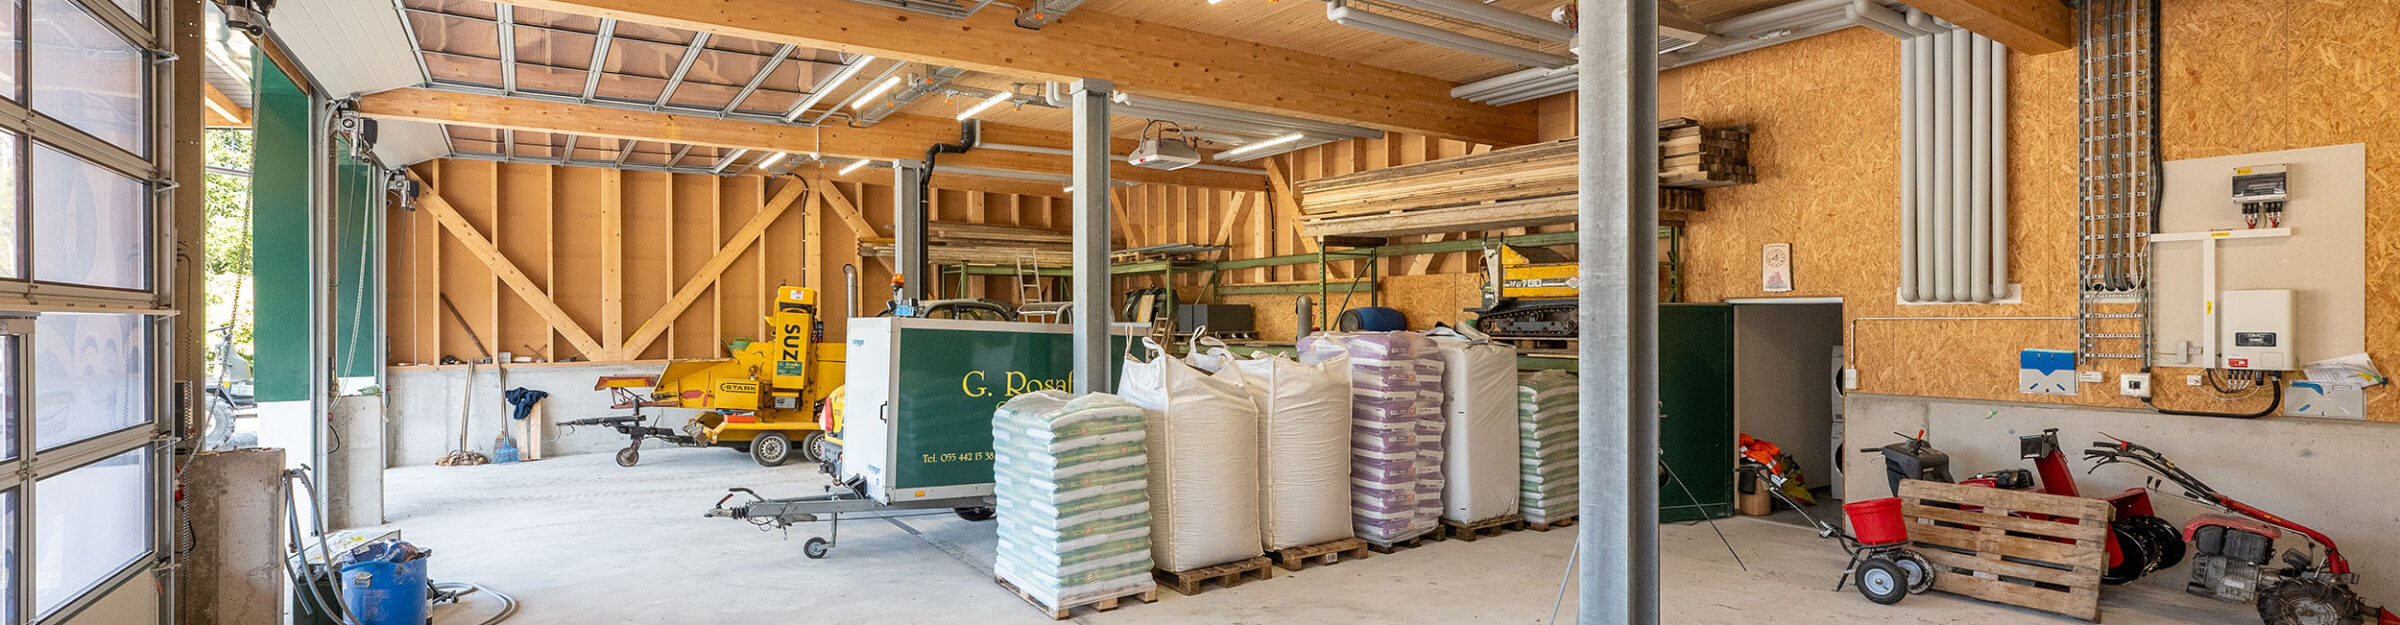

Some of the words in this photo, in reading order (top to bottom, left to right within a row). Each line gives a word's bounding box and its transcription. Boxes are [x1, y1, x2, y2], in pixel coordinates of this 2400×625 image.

[783, 324, 801, 362] SUZ
[962, 370, 993, 398] G.
[940, 453, 956, 462] 055
[959, 452, 972, 462] 442
[975, 451, 983, 461] 15
